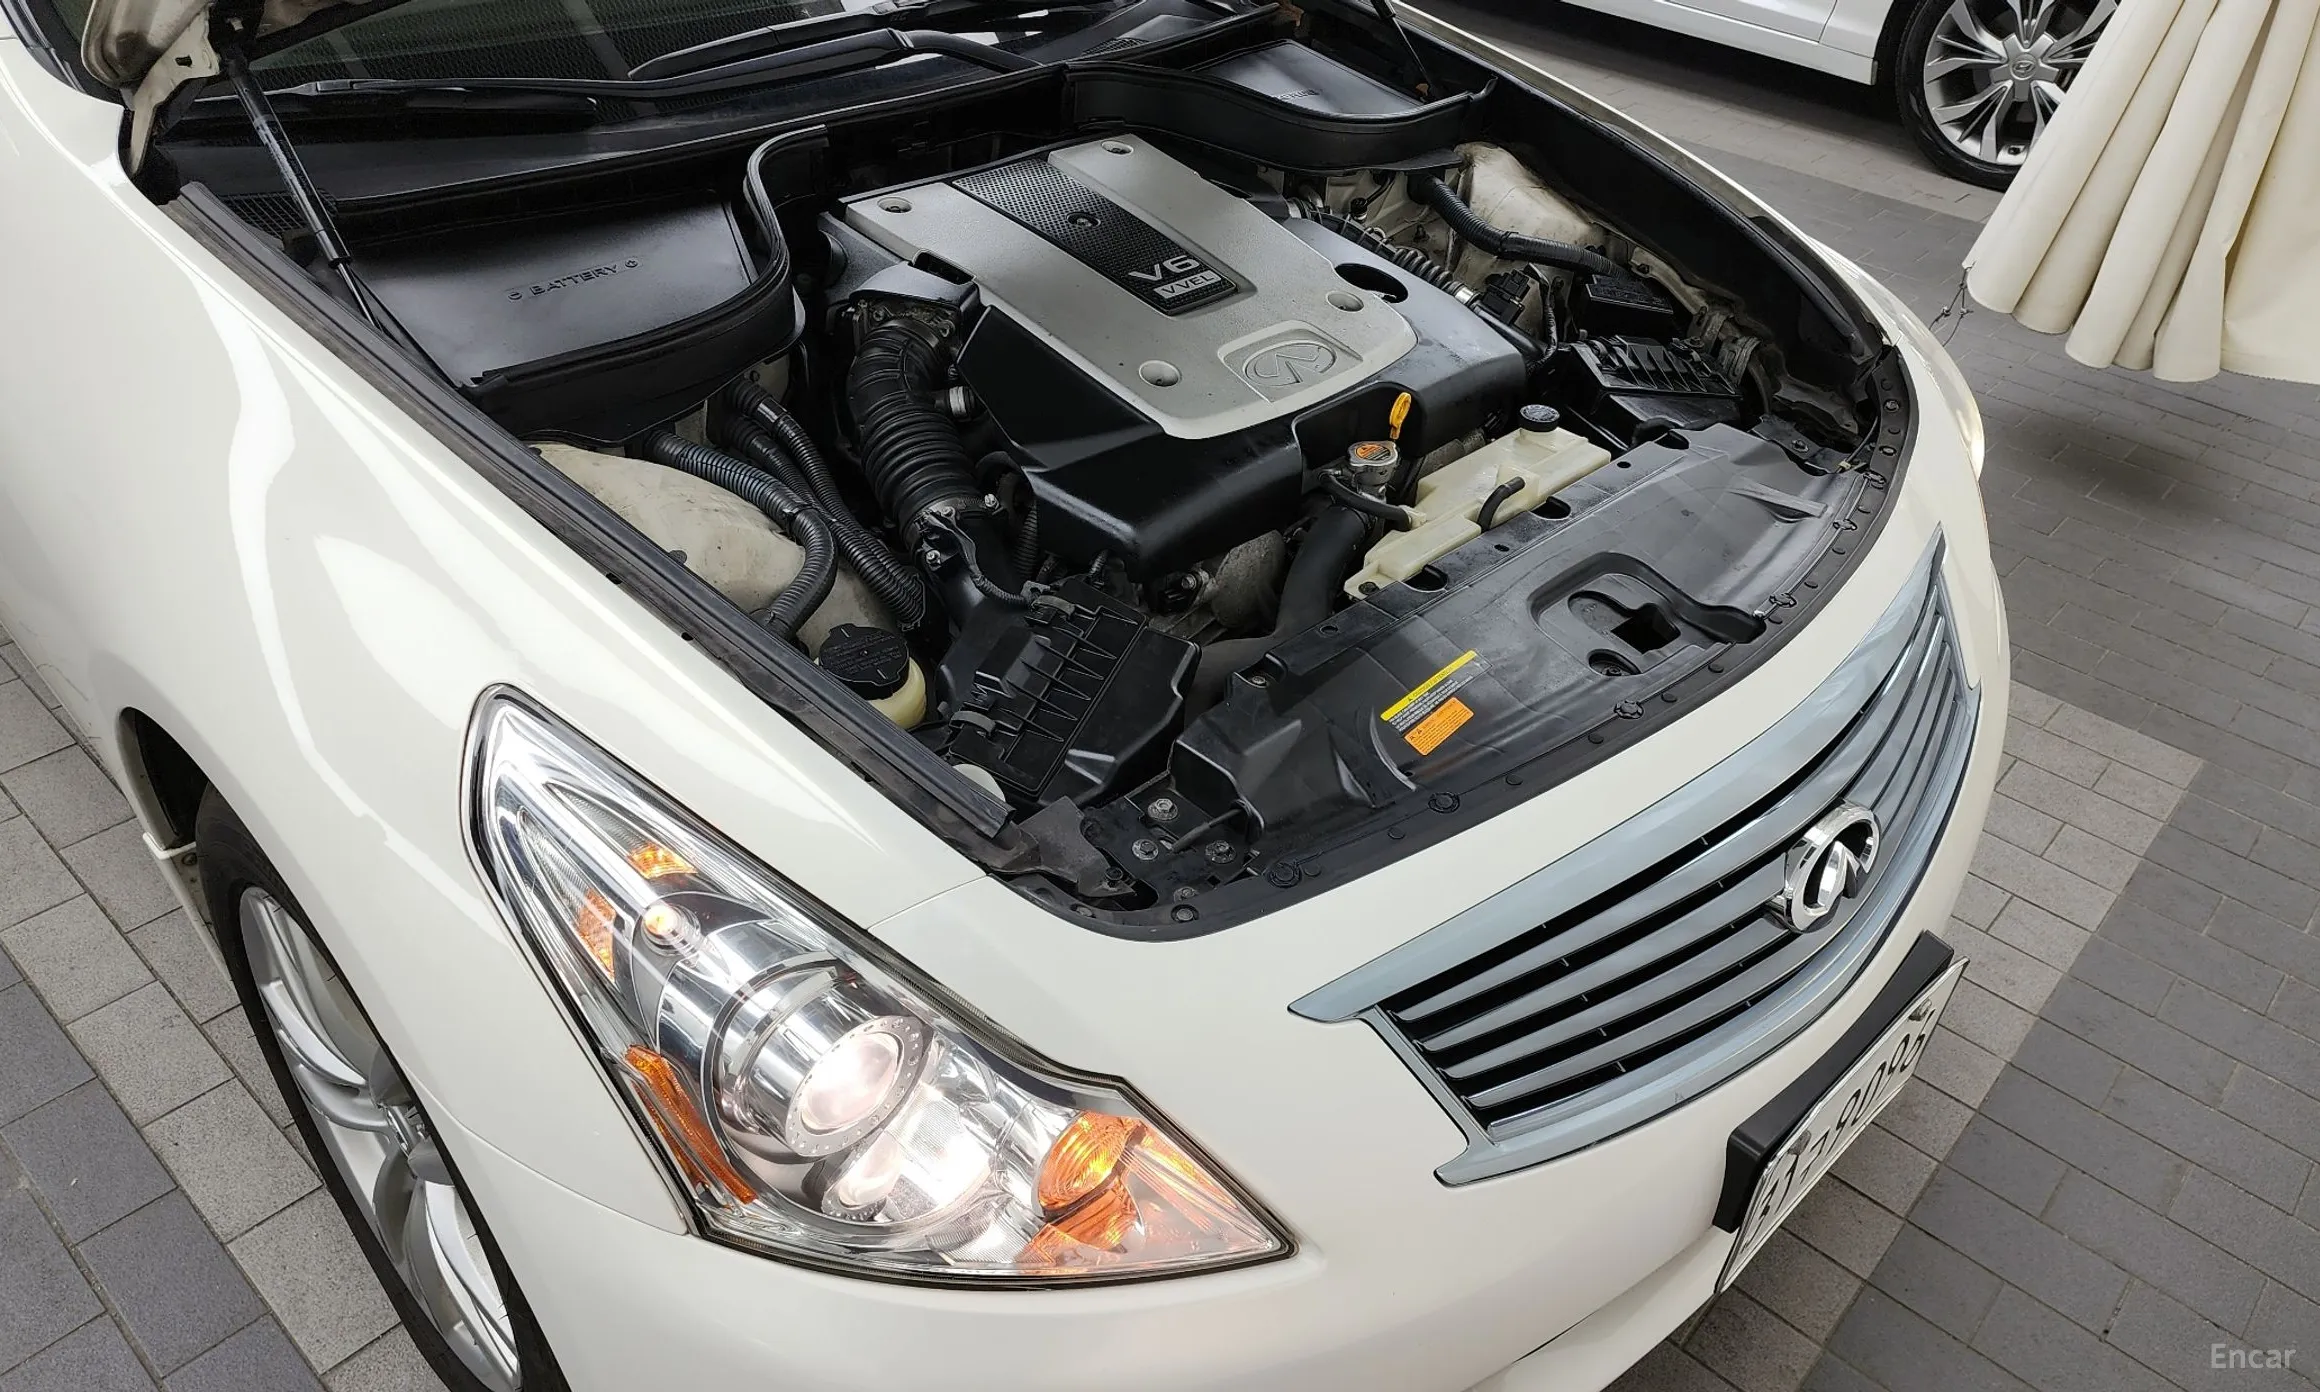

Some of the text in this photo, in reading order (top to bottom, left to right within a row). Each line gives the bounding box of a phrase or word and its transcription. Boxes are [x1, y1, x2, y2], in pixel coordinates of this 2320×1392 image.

[529, 264, 618, 295] BATTERY
[1128, 254, 1200, 281] V6
[1161, 273, 1215, 294] VVEL
